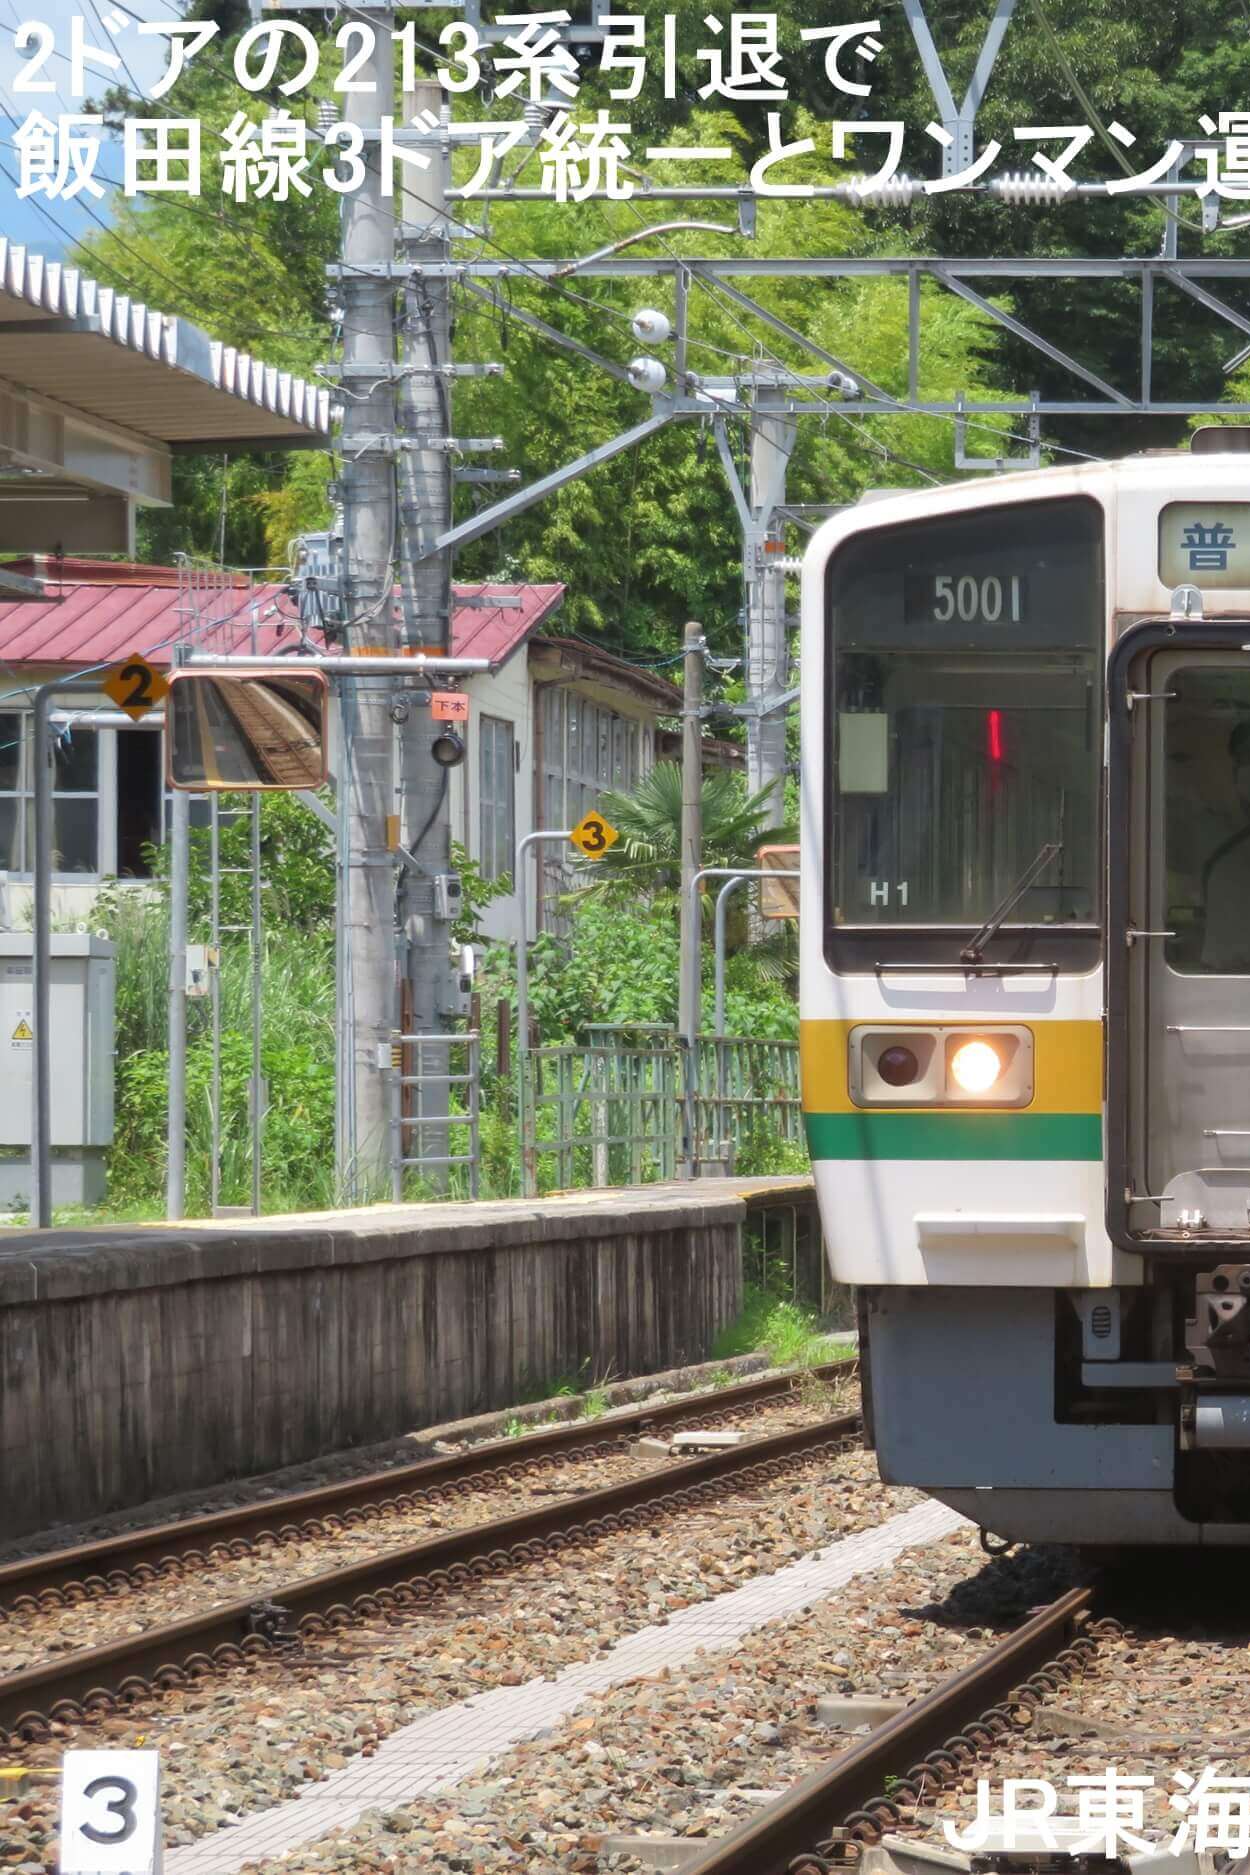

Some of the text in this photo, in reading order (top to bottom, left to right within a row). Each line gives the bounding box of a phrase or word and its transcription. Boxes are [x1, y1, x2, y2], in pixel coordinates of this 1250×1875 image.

[934, 575, 1020, 622] 5001
[120, 664, 153, 706] 2
[434, 700, 465, 712] 下本
[582, 821, 605, 851] 3
[79, 1775, 138, 1846] 3
